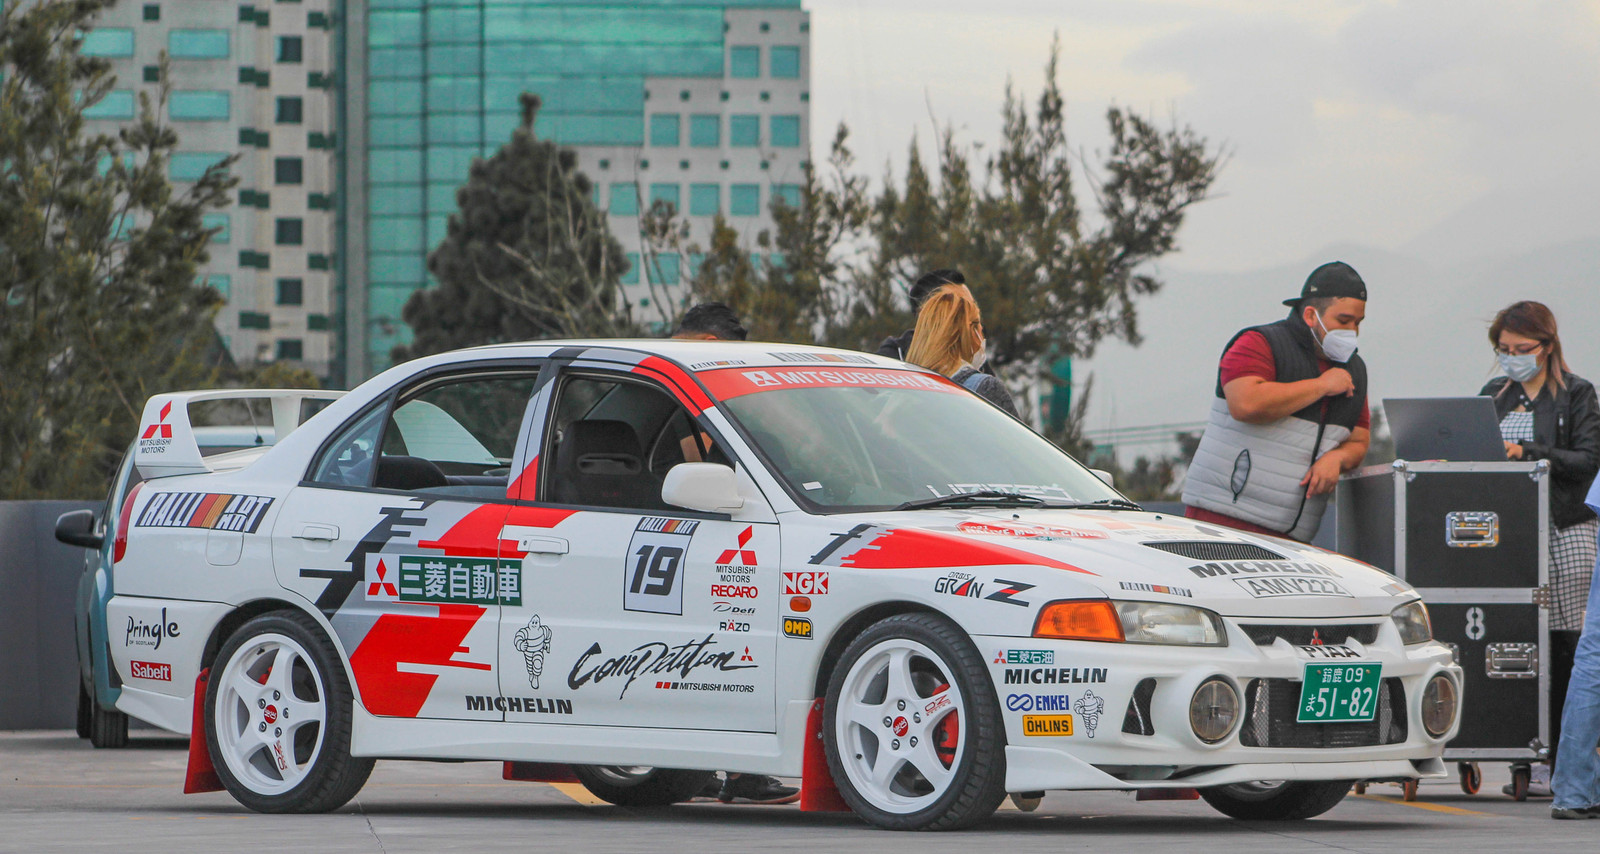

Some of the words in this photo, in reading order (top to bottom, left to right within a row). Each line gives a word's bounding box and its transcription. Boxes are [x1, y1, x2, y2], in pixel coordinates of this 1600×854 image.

[776, 371, 922, 387] MITSUBISHI
[141, 446, 166, 454] MOTORS
[630, 545, 684, 596] 19
[716, 565, 756, 575] MITSUBISHI
[1188, 560, 1344, 579] MICHELIN
[401, 561, 521, 601] 三菱自動車
[720, 574, 751, 584] MOTORS
[782, 572, 829, 594] NGK
[1248, 579, 1347, 595] AMV222
[711, 584, 758, 599] RECARO
[731, 606, 756, 614] Defi
[126, 607, 180, 650] Pringle
[784, 620, 811, 636] OMP
[1465, 607, 1485, 640] 8
[1008, 650, 1054, 664] 三菱石油
[1300, 645, 1362, 658] PIAA
[132, 662, 169, 680] Sabelt
[1004, 668, 1108, 684] MICHELIN
[1345, 667, 1364, 683] 09
[680, 682, 722, 691] MITSUBISHI
[722, 684, 755, 693] MOTORS
[465, 695, 573, 714] MICHELIN
[1035, 695, 1070, 711] ENKEI
[1315, 687, 1373, 717] 51-82
[1027, 716, 1069, 732] ÖHLINS
